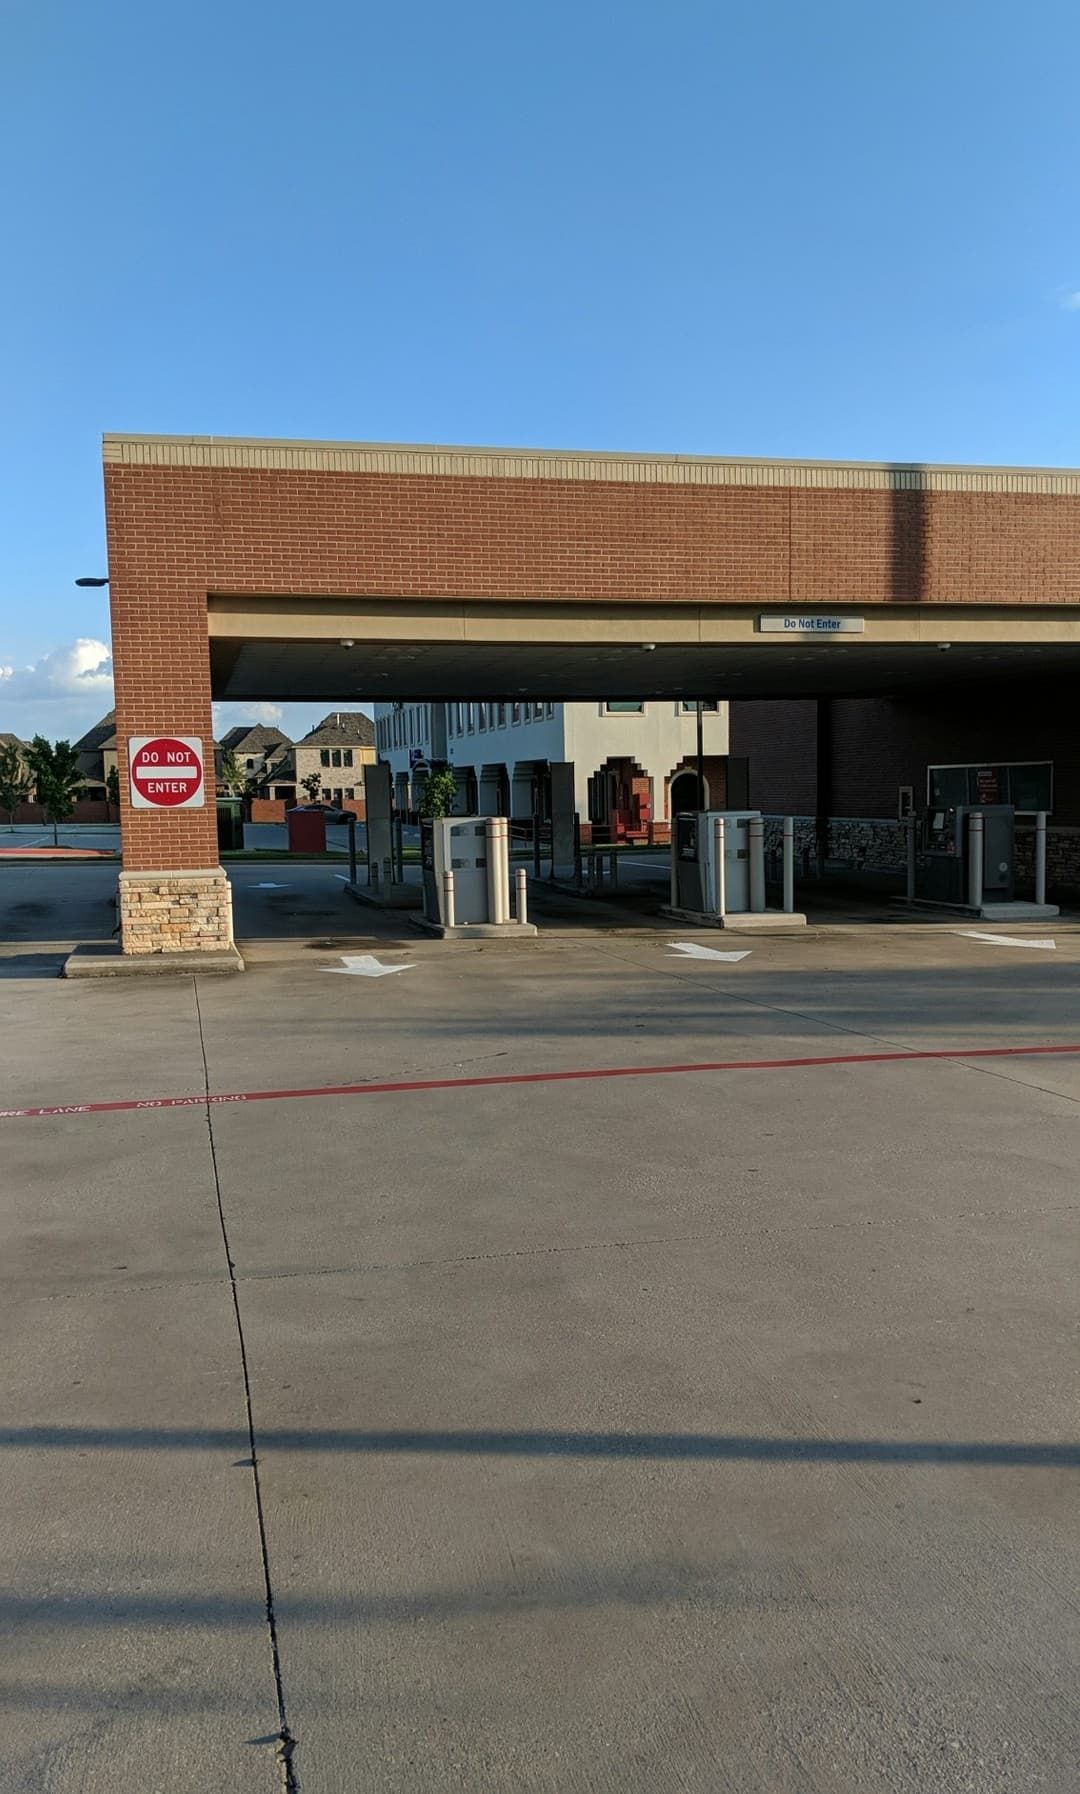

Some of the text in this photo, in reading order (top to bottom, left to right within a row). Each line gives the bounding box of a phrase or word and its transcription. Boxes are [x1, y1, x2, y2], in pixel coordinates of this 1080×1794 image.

[784, 619, 841, 629] Do Not Enter
[142, 752, 191, 763] DO NOT
[148, 782, 187, 793] ENTER
[39, 1105, 91, 1115] LANE
